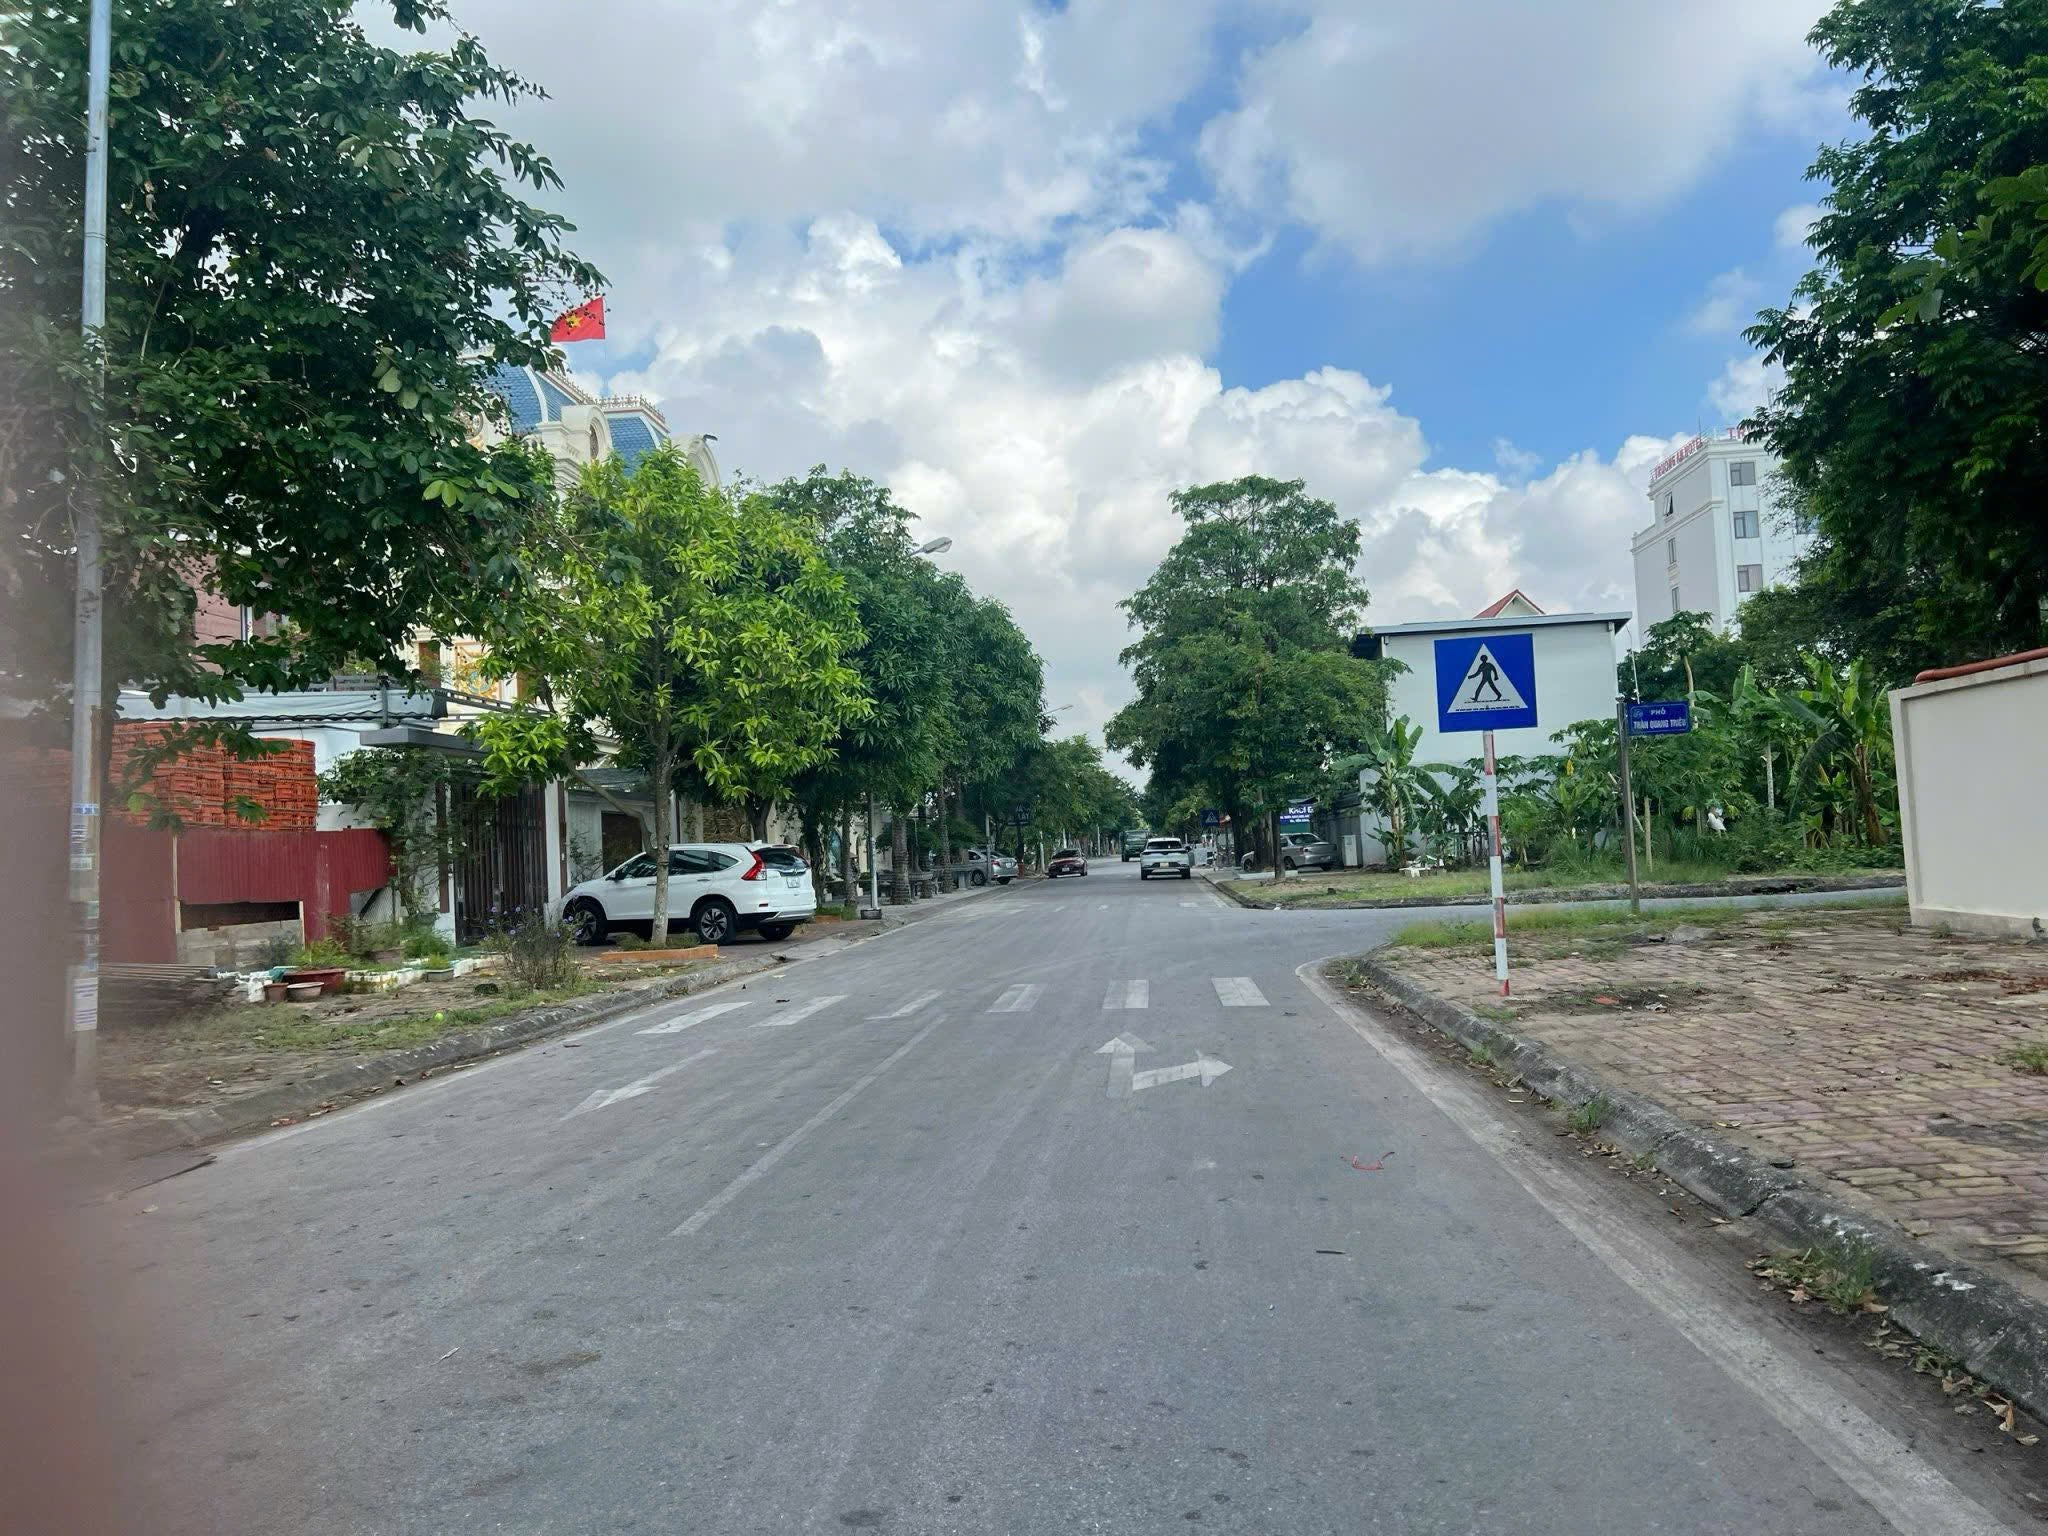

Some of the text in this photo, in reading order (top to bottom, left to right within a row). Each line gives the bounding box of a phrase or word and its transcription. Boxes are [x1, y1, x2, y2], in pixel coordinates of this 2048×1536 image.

[1651, 706, 1666, 715] PHỐ
[1633, 718, 1648, 729] TRẦN
[1650, 719, 1669, 729] QUANG
